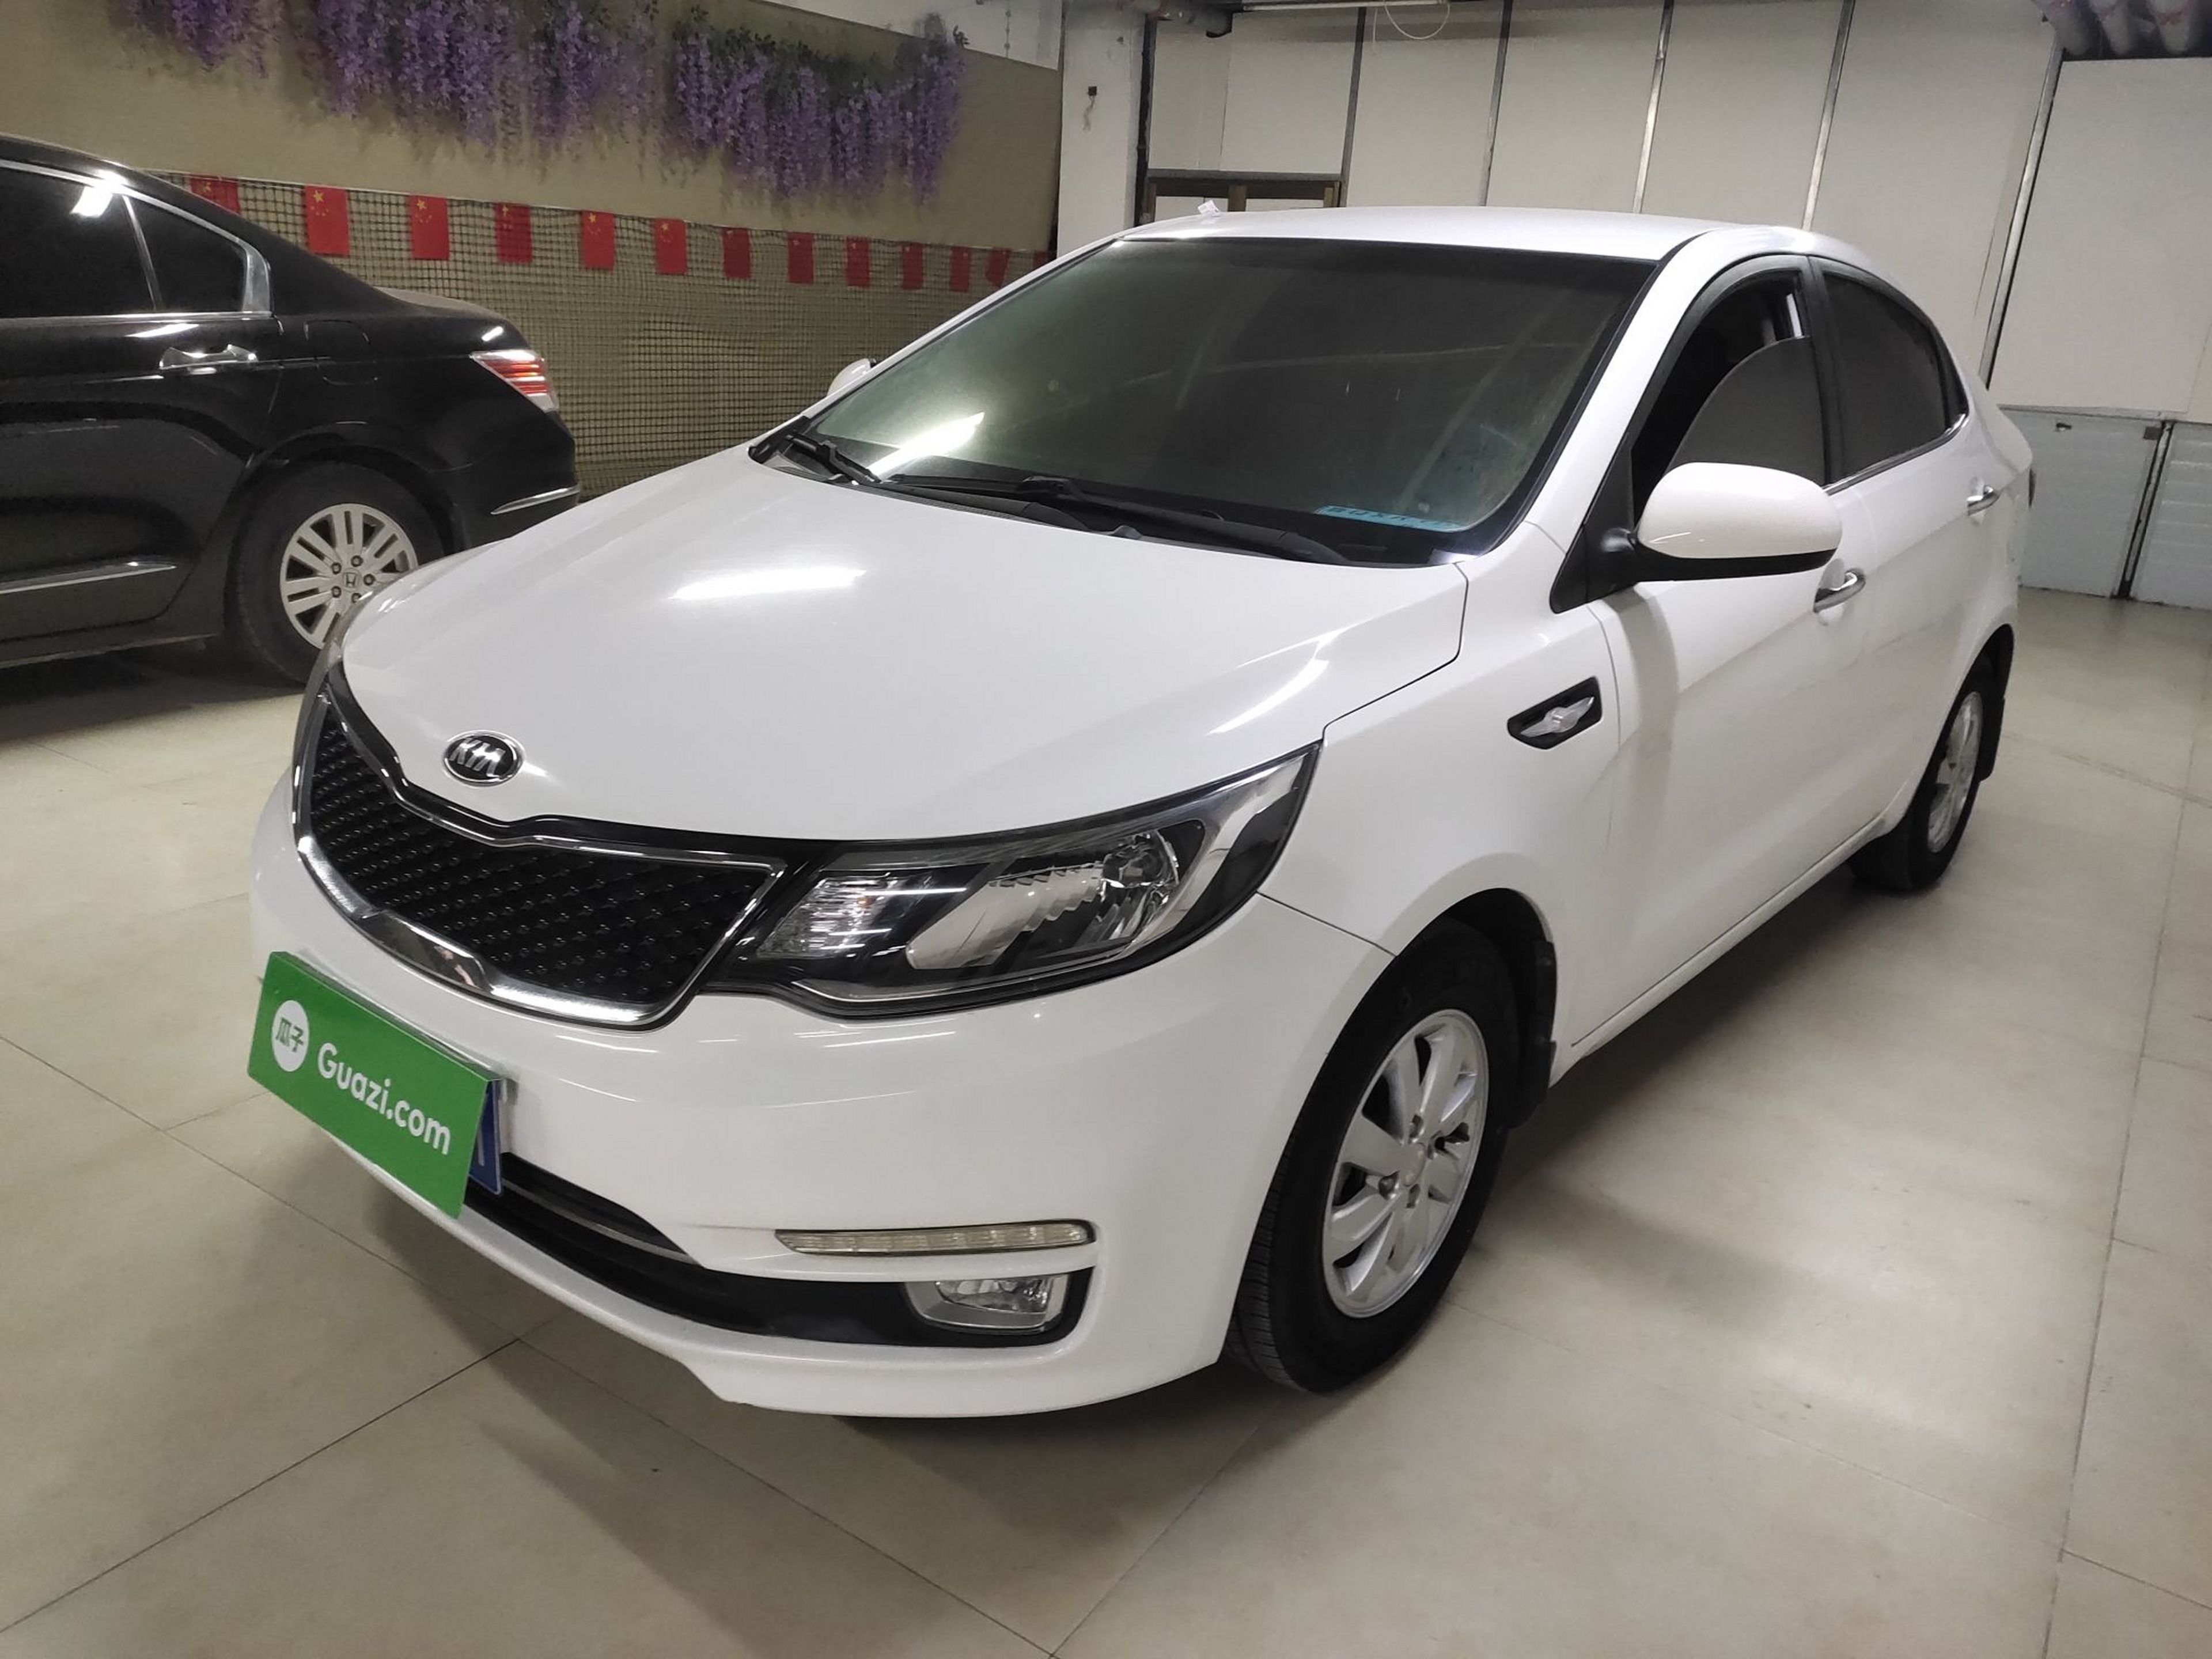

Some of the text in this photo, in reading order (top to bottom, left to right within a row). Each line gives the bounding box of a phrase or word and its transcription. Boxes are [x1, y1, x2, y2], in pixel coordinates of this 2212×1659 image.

[449, 737, 506, 776] KIA
[275, 1017, 304, 1053] 瓜子
[317, 1042, 450, 1155] Guazi.com
